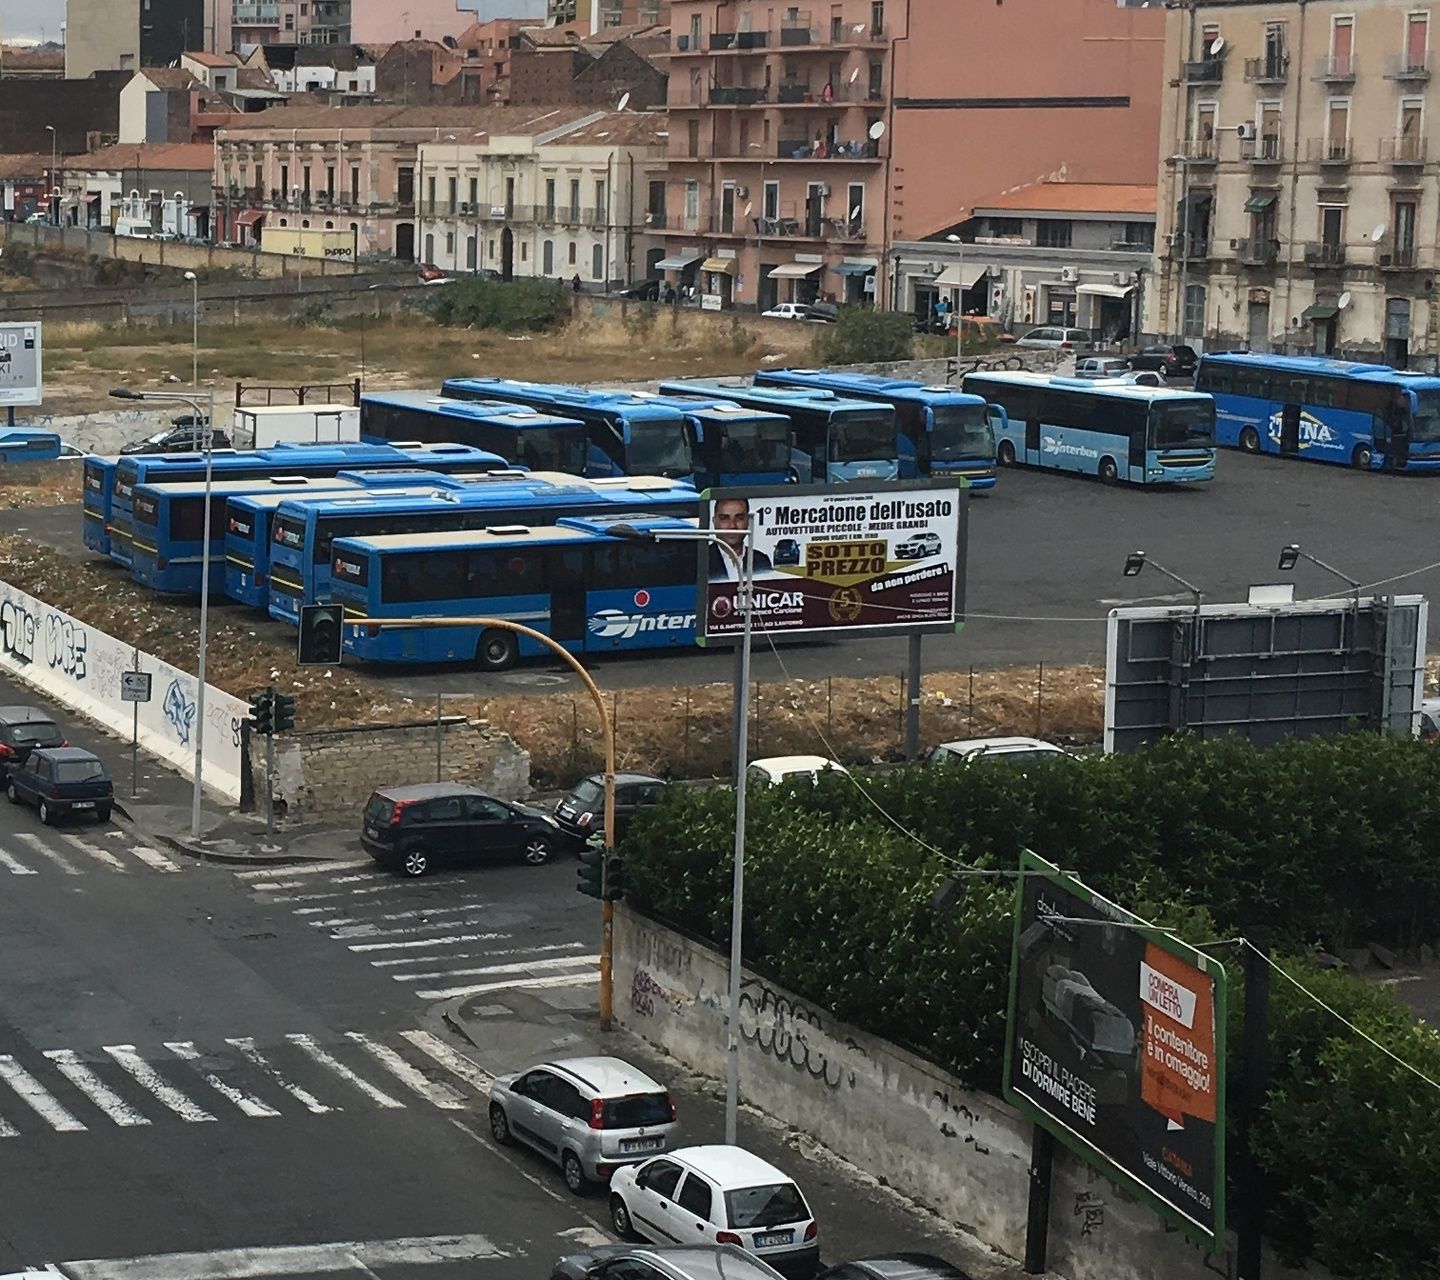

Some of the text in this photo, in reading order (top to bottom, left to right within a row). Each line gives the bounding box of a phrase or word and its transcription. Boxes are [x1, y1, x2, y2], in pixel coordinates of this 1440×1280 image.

[775, 505, 866, 526] Mercatone
[870, 499, 952, 521] dell'usato
[765, 525, 825, 536] AUTOVETTURE
[827, 523, 862, 533] PICCOLE
[868, 521, 895, 531] MEDIE
[896, 519, 928, 529] GRANDI
[807, 542, 885, 559] SOTTO
[807, 558, 885, 577] PREZZO
[870, 582, 884, 593] da
[885, 578, 904, 589] non
[905, 567, 943, 584] perdere
[733, 592, 805, 610] UNICAR
[1148, 973, 1180, 1004] COMPRA
[1148, 990, 1182, 1019] UN LETTO
[1153, 1023, 1208, 1069] contenitore
[1023, 1040, 1052, 1075] SCOPRI
[1061, 1067, 1096, 1107] PIACERE
[1154, 1040, 1164, 1064] in
[1165, 1053, 1210, 1093] omaggio!
[1022, 1058, 1096, 1126] DI DORMIRE BENE
